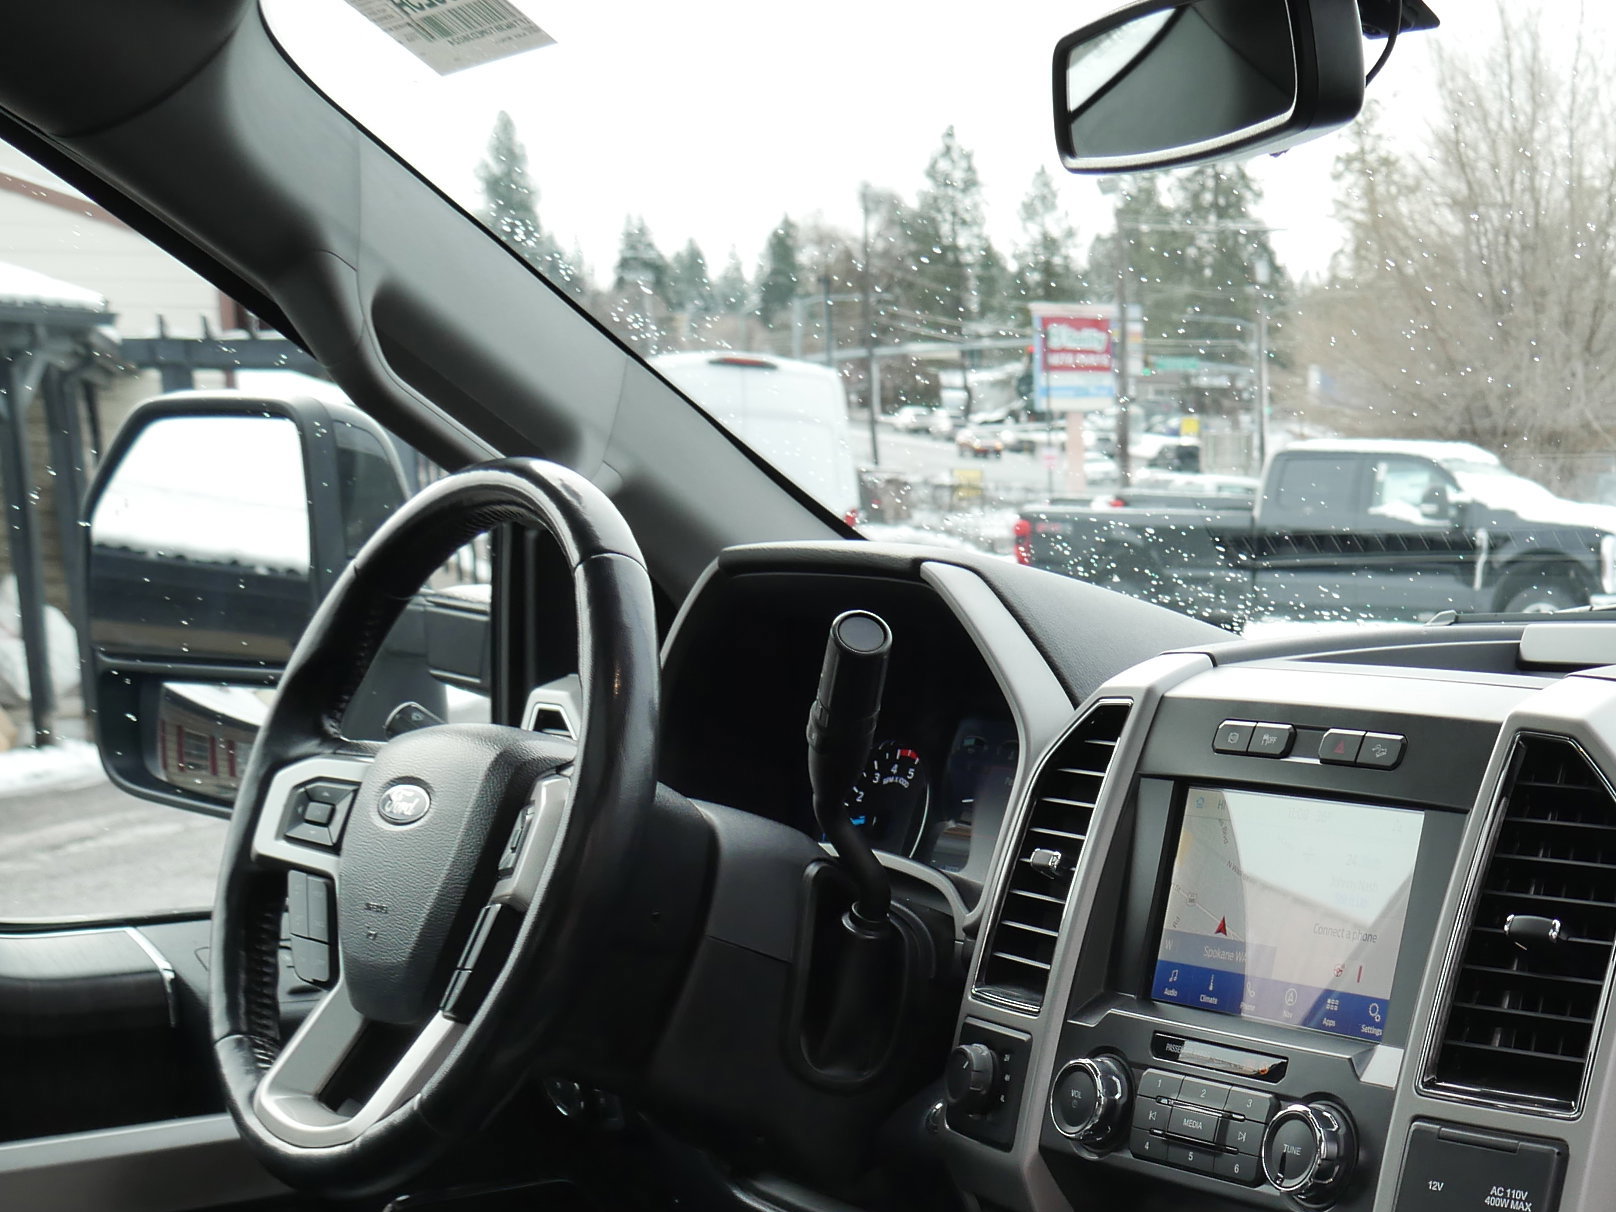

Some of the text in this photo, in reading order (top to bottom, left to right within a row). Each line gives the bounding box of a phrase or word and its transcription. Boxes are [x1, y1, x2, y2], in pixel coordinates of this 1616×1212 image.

[1313, 923, 1344, 940] Connect
[1352, 929, 1378, 944] phone
[1203, 946, 1235, 961] Spokane
[1163, 987, 1178, 997] Audio
[1199, 994, 1218, 1005] Climate
[1322, 1017, 1336, 1027] Apps
[1360, 1024, 1383, 1037] Settings
[1071, 1088, 1082, 1099] VOL
[1200, 1088, 1207, 1098] 2
[1246, 1098, 1252, 1108] 3
[1182, 1117, 1203, 1131] MEDIA
[1144, 1141, 1149, 1151] 4
[1283, 1143, 1302, 1156] TUNE
[1187, 1151, 1194, 1161] 5
[1233, 1163, 1240, 1174] 6
[1428, 1180, 1444, 1191] 12V
[1490, 1186, 1528, 1200] AC 110V
[1484, 1196, 1532, 1212] 400W MAX
